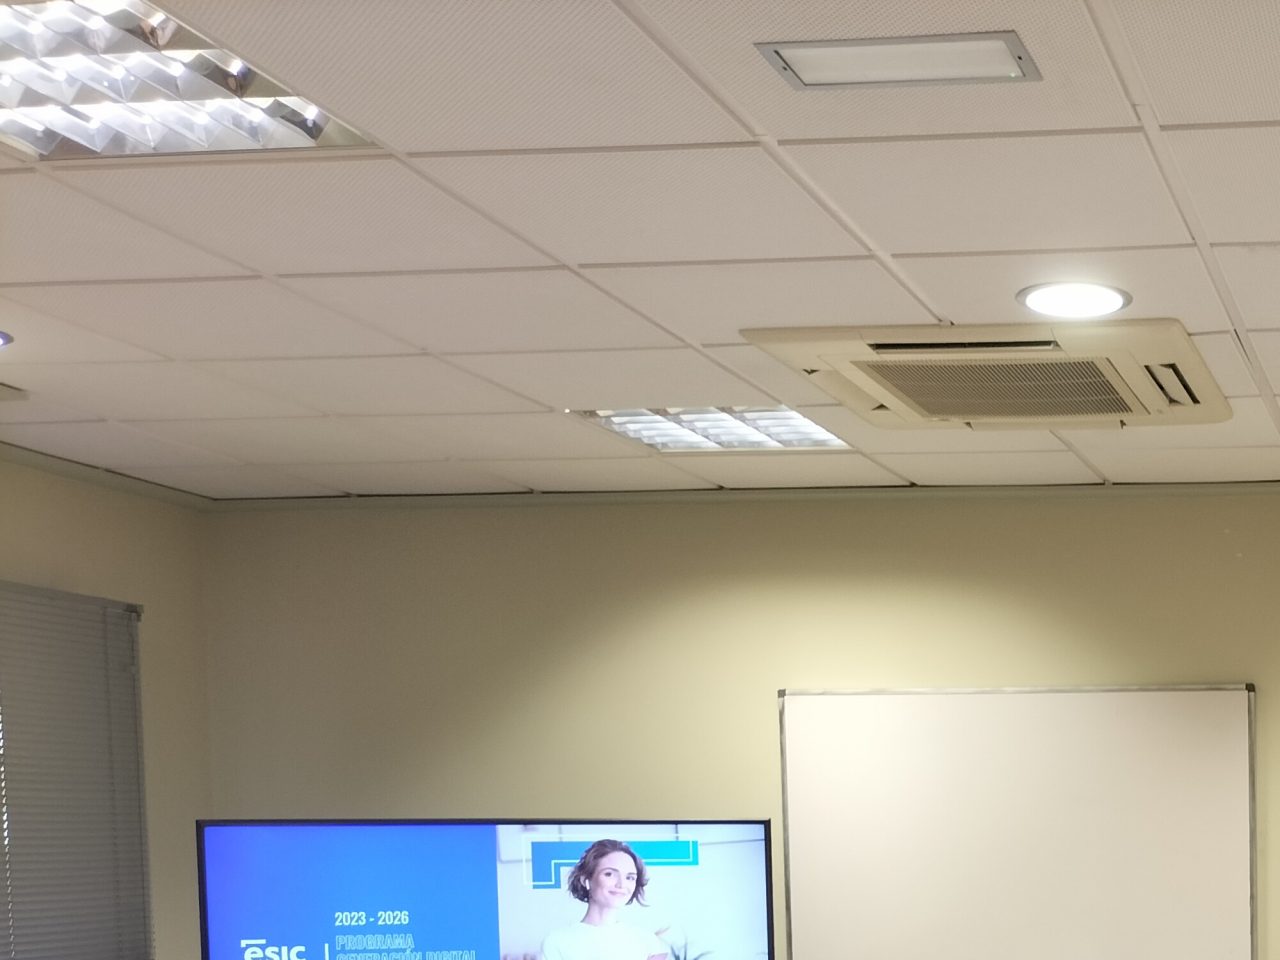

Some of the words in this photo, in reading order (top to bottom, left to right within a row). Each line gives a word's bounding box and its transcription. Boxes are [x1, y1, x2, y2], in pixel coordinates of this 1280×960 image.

[334, 911, 367, 926] 2023
[377, 910, 410, 926] 2026
[335, 934, 415, 951] PROGRAMA
